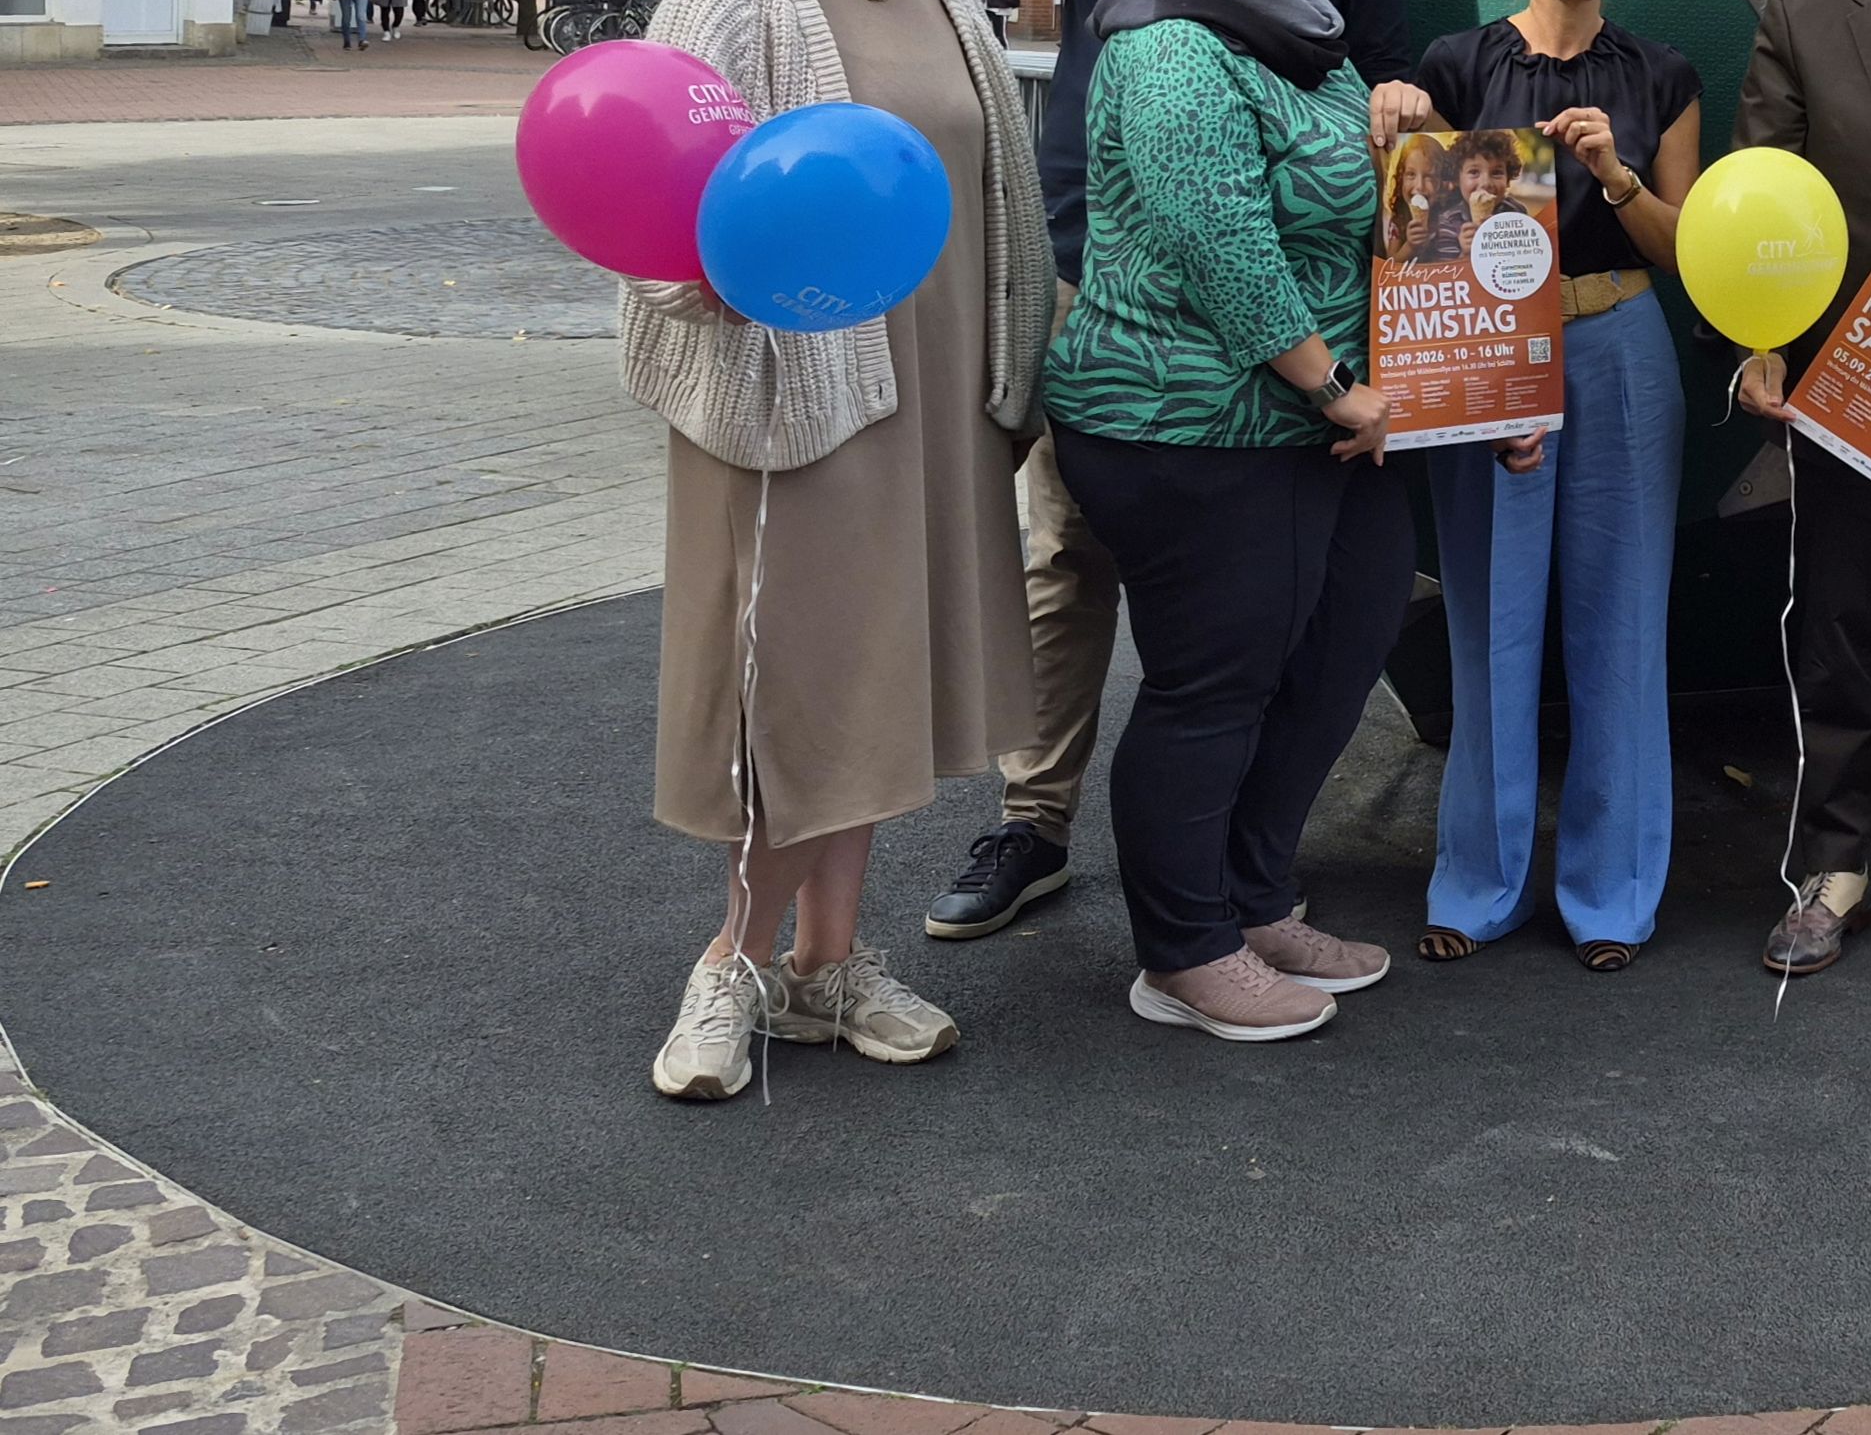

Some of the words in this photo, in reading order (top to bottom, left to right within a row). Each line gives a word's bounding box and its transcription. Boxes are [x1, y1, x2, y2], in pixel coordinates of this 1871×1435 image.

[688, 84, 729, 103] CITY
[1482, 229, 1529, 240] PROGRAMM
[1494, 220, 1524, 230] BUNTES
[1757, 240, 1797, 259] CITY
[797, 286, 853, 314] CITY
[1379, 280, 1471, 311] KINDER
[1379, 303, 1517, 344] SAMSTAG
[1380, 350, 1445, 367] 05.09.2026
[1453, 347, 1468, 360] 10
[1478, 346, 1493, 358] 16
[1494, 343, 1515, 356] Uhr
